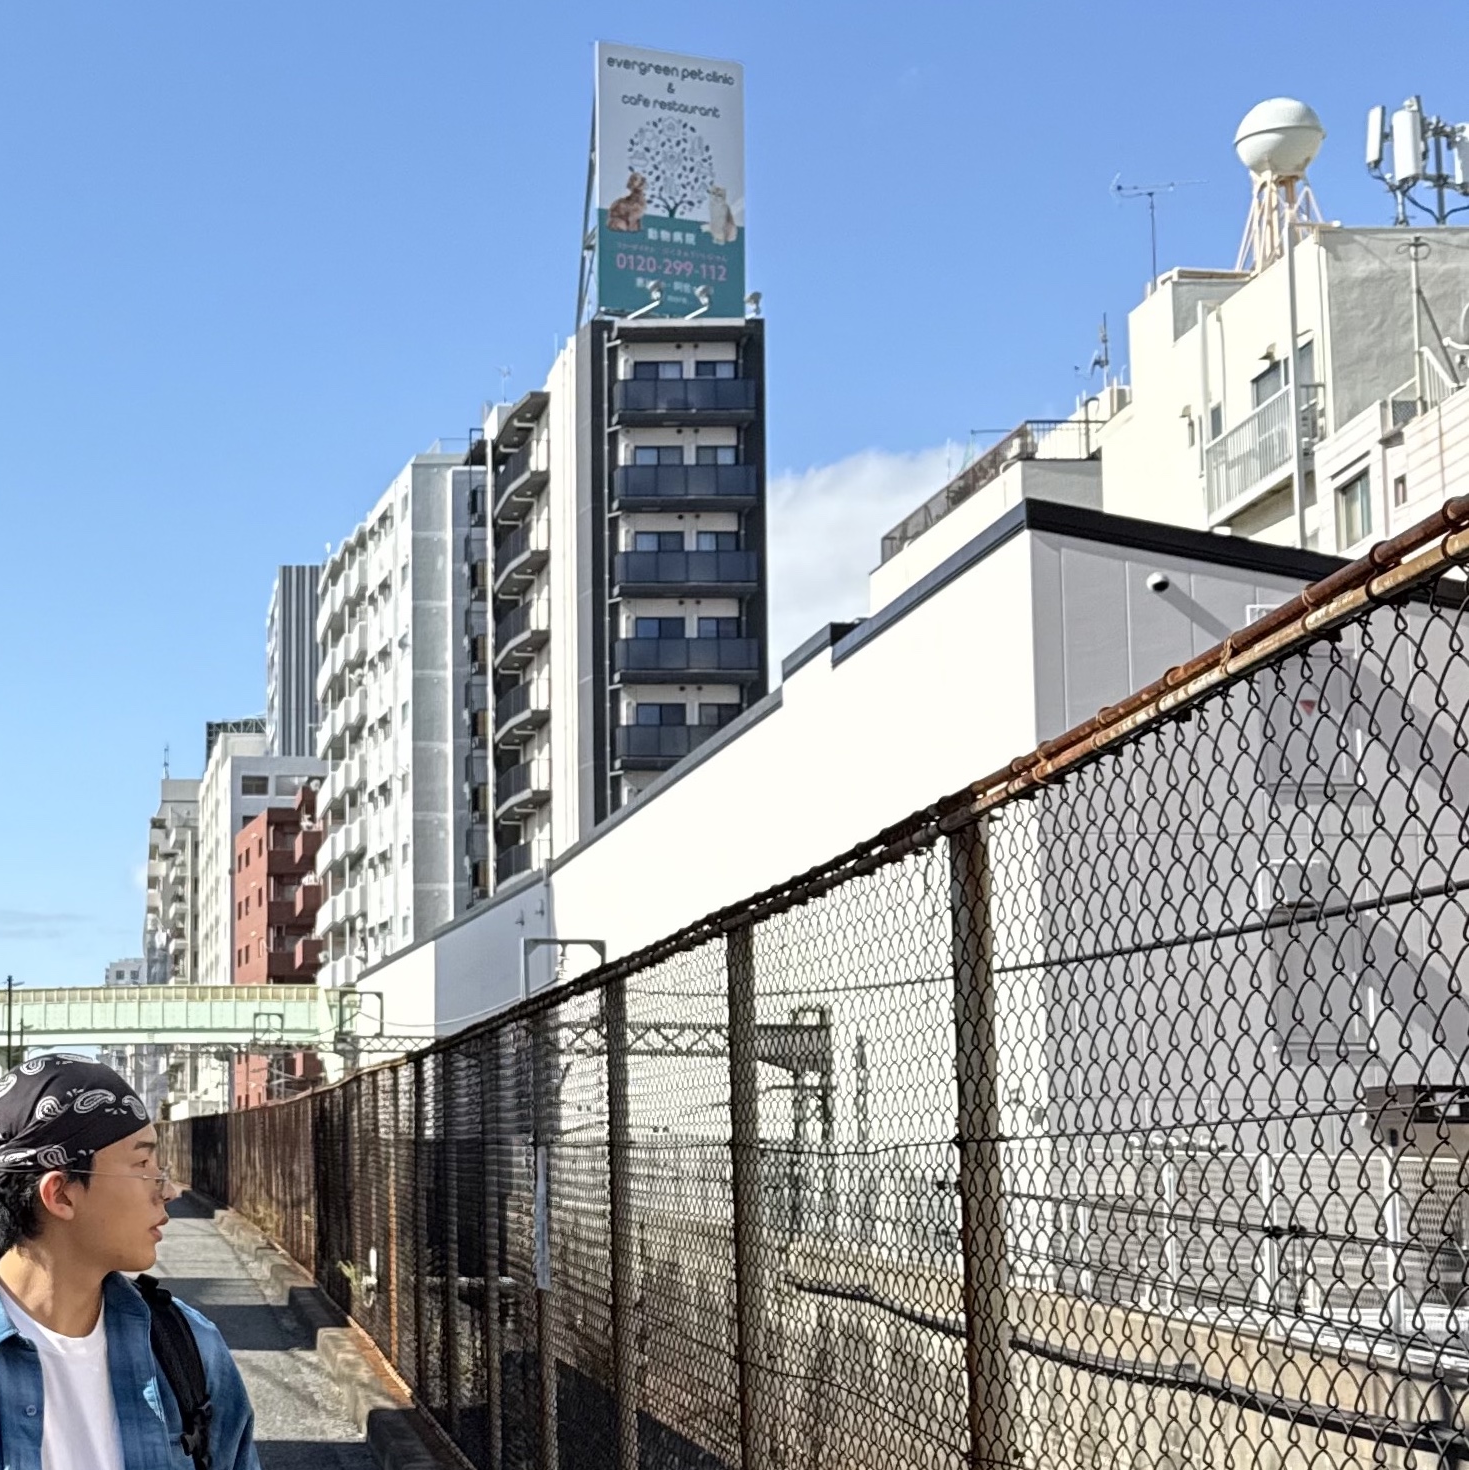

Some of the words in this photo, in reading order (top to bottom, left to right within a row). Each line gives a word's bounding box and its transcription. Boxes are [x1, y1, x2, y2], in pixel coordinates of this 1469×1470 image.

[606, 57, 679, 77] evergreen
[681, 68, 704, 81] pet
[705, 71, 735, 86] clinic
[667, 82, 676, 94] &
[621, 94, 650, 108] cafe
[652, 100, 720, 118] restaurant
